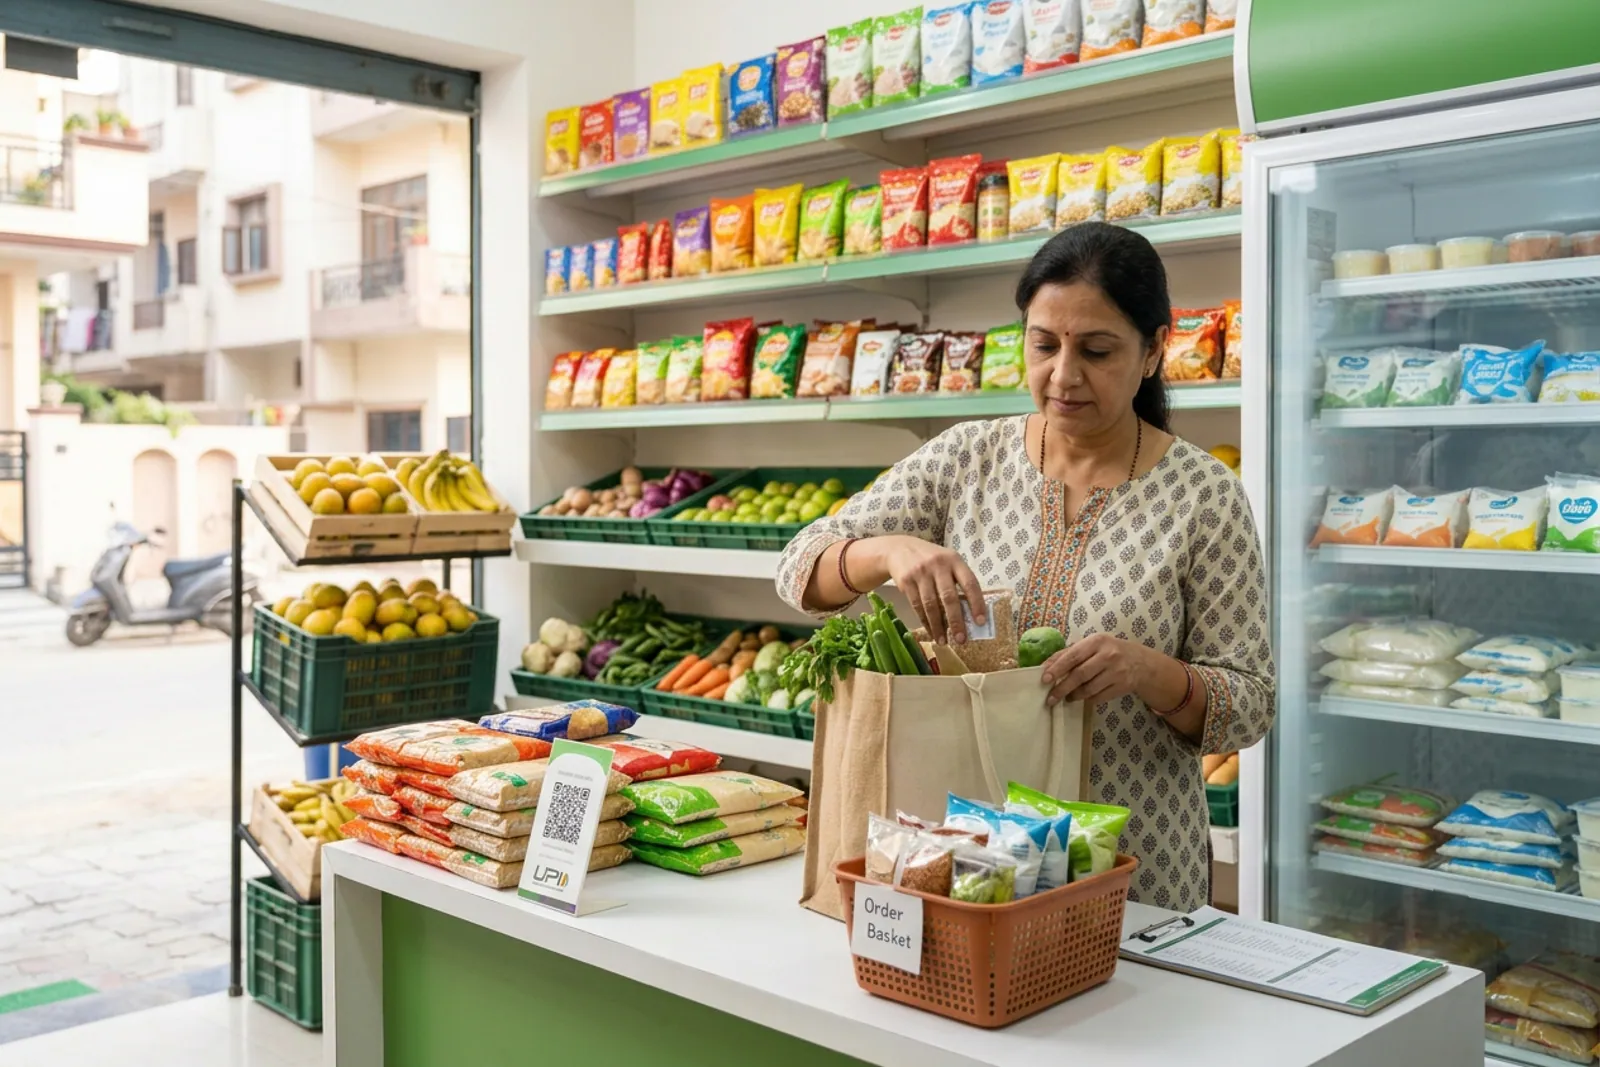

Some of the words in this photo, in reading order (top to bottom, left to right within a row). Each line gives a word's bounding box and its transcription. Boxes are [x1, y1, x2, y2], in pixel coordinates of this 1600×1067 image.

[533, 865, 564, 886] UPI
[865, 897, 903, 920] Order
[867, 922, 911, 948] Basket
